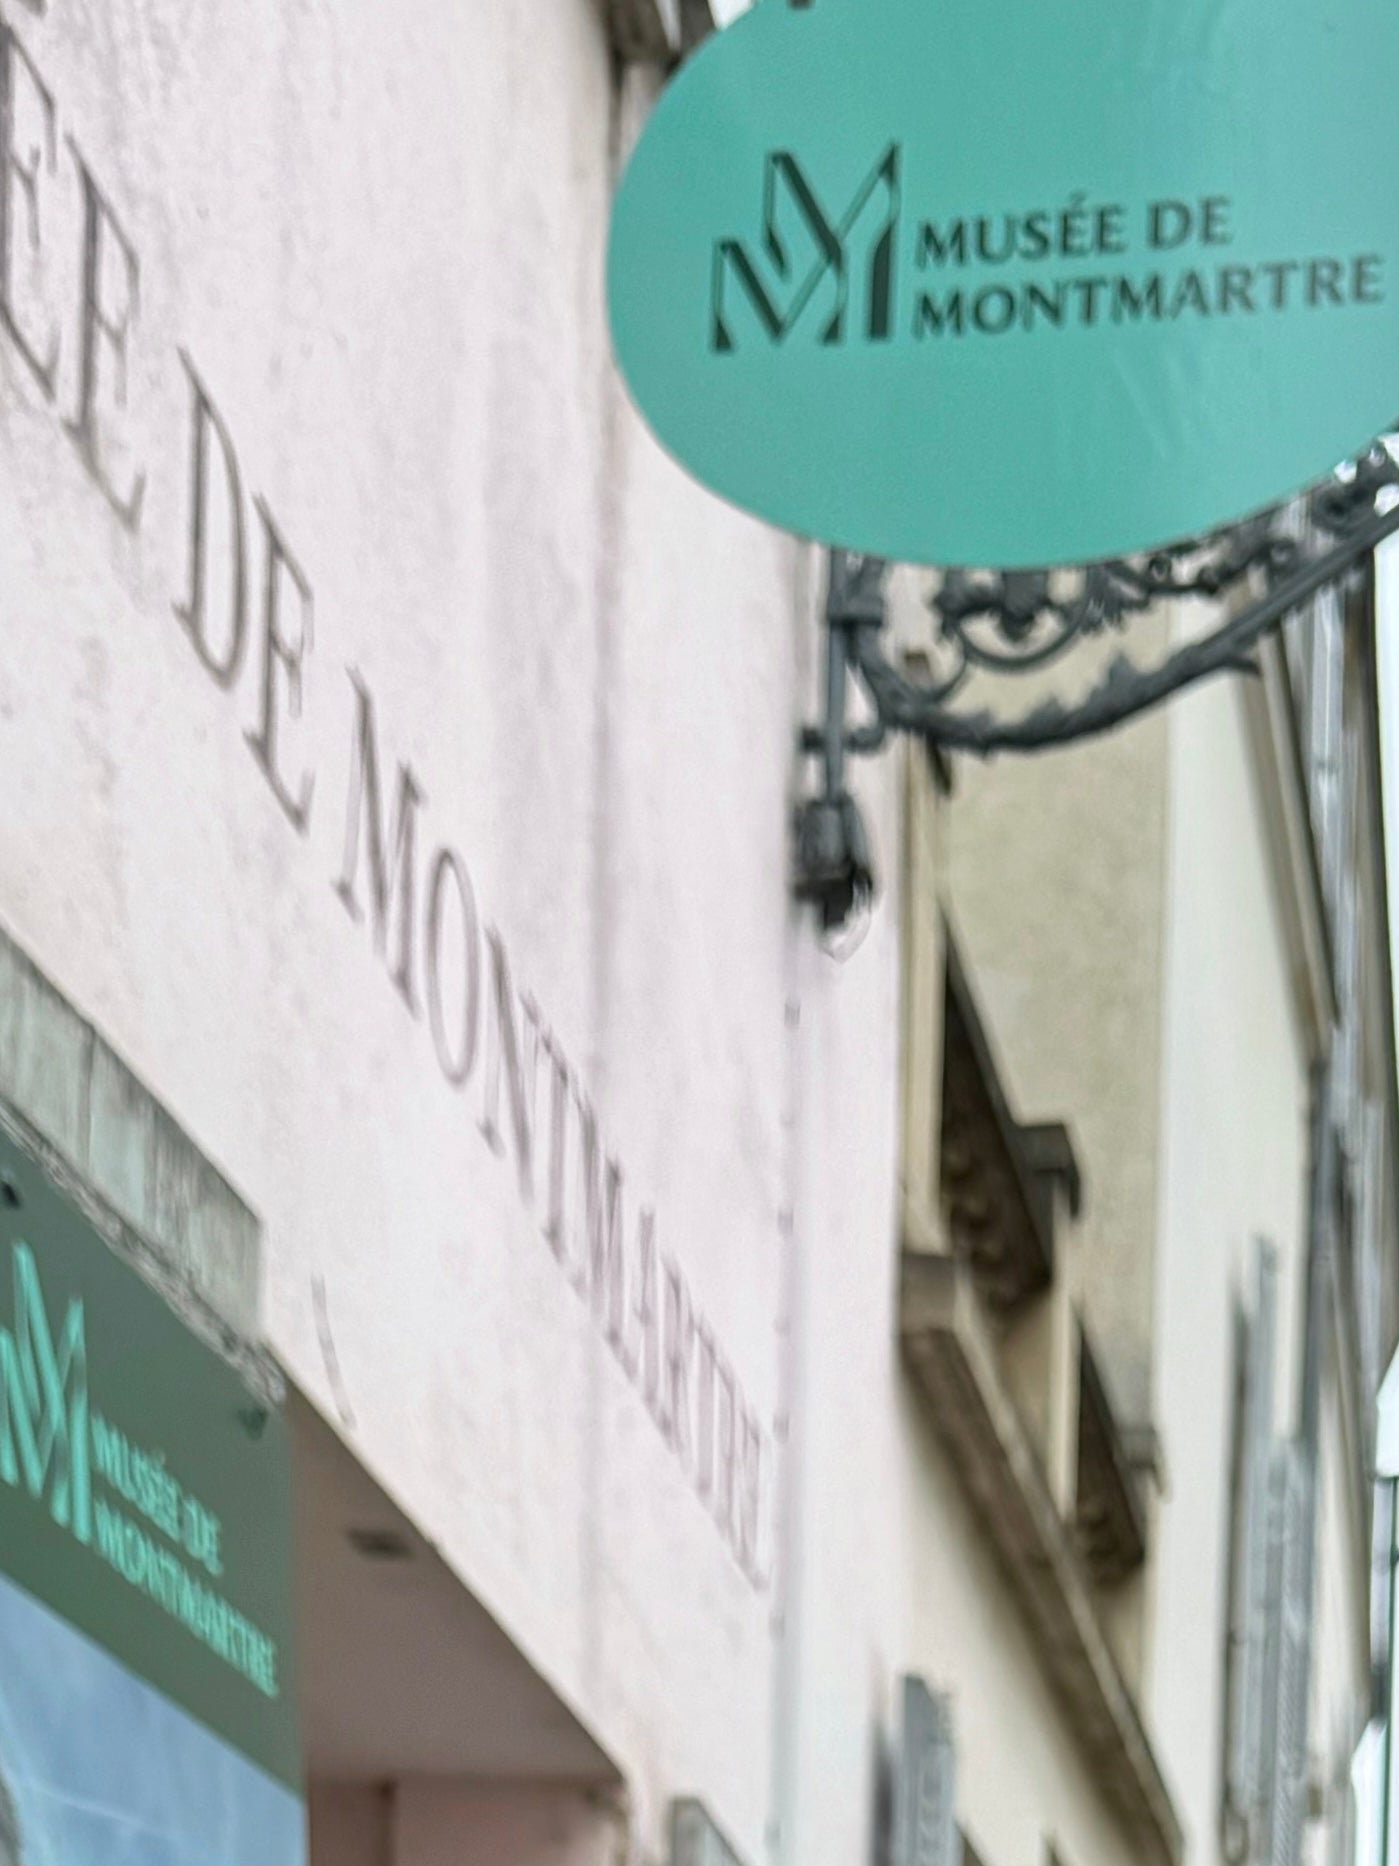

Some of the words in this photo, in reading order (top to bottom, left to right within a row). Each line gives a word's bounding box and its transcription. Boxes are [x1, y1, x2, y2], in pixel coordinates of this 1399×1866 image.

[914, 191, 1130, 270] MUSÉE
[1145, 196, 1236, 250] DE
[912, 254, 1387, 342] MONTMARTRE
[171, 345, 315, 837] DE
[182, 1493, 224, 1577] DE
